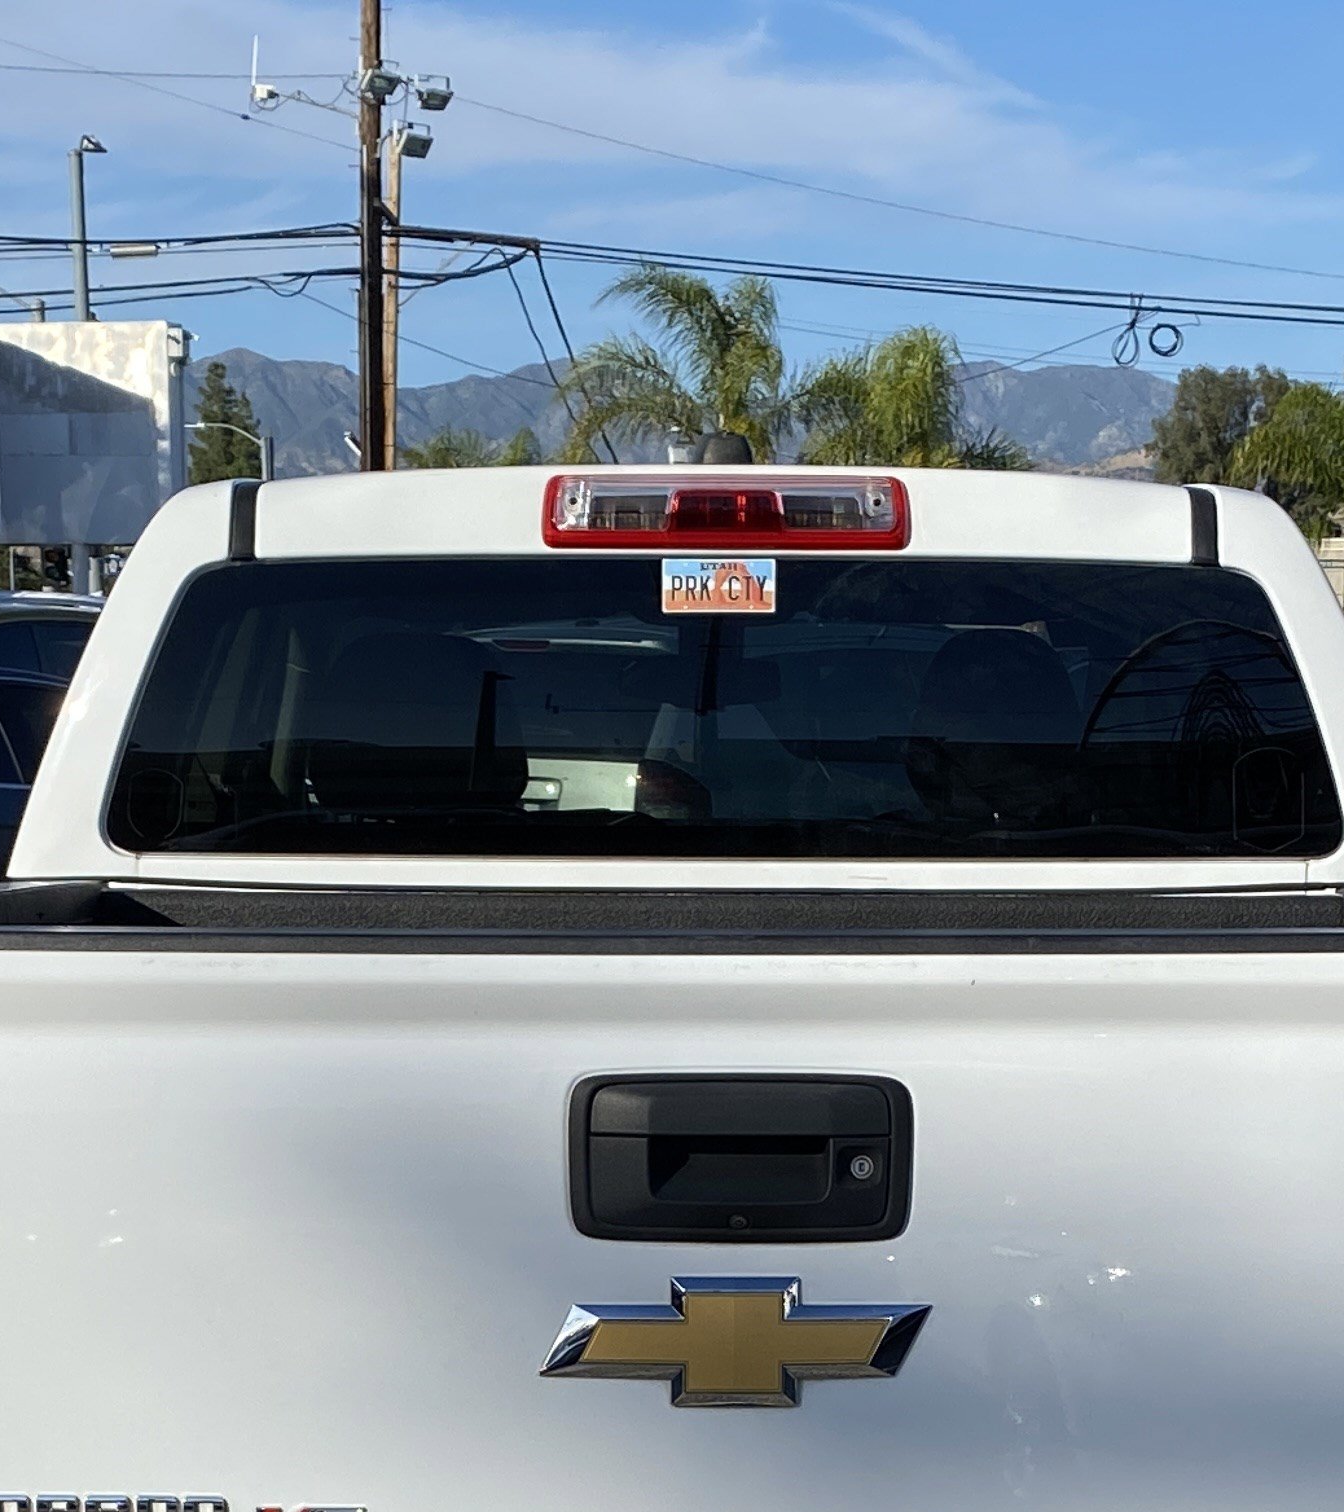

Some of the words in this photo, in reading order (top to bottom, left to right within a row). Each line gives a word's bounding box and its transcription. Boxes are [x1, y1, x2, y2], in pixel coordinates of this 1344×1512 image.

[700, 562, 738, 571] UTAH
[671, 575, 712, 601] PRK
[729, 575, 767, 601] CTY
